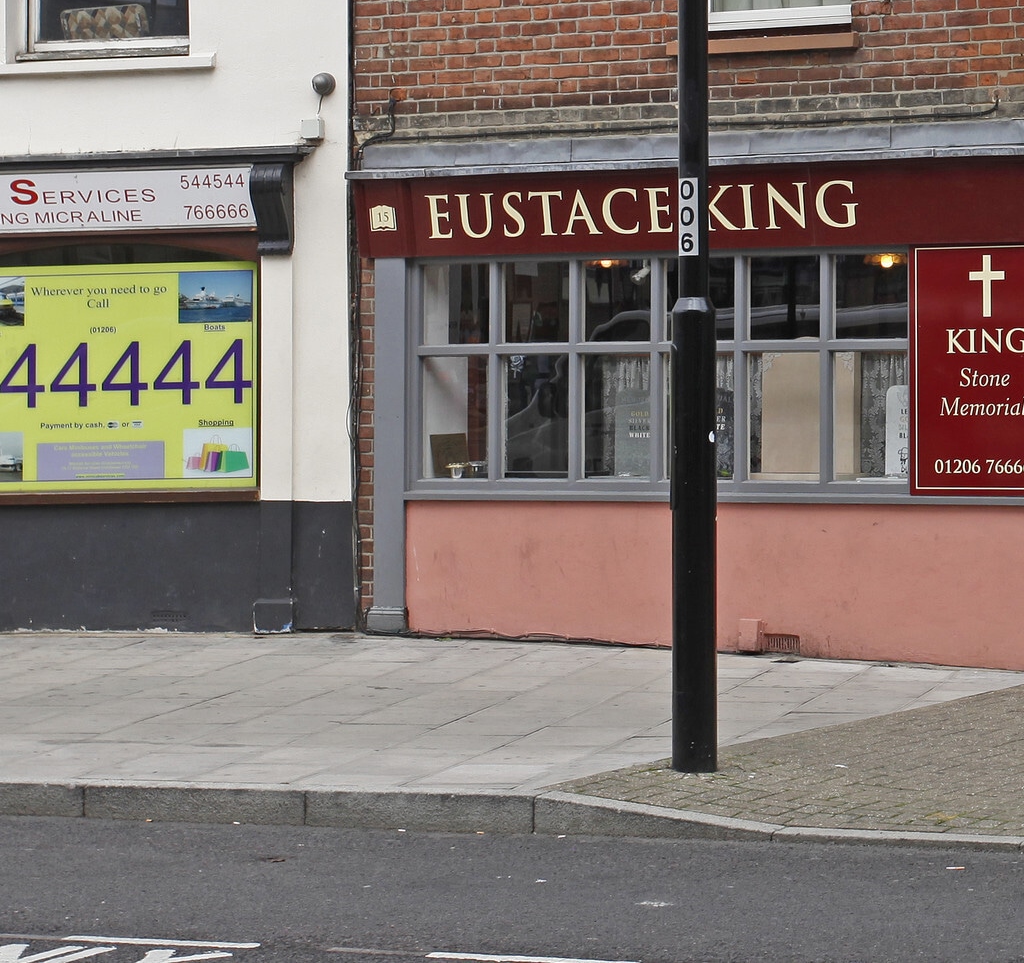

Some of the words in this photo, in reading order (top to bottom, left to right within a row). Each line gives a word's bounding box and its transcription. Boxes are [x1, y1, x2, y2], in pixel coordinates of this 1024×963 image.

[180, 173, 245, 190] 544544
[183, 203, 249, 220] 766666
[424, 186, 673, 239] EUSTACE
[708, 180, 860, 231] KING
[377, 212, 389, 223] 15
[680, 180, 695, 253] 006
[31, 286, 83, 296] Wherever
[87, 288, 107, 297] you
[110, 285, 136, 294] need
[139, 286, 150, 294] to
[153, 286, 167, 295] go
[87, 299, 109, 309] Call
[89, 326, 117, 334] (01206)
[959, 368, 1010, 387] Stone
[40, 422, 73, 430] Payment
[74, 422, 84, 430] by
[198, 419, 234, 427] Shopping
[934, 459, 981, 474] 01206
